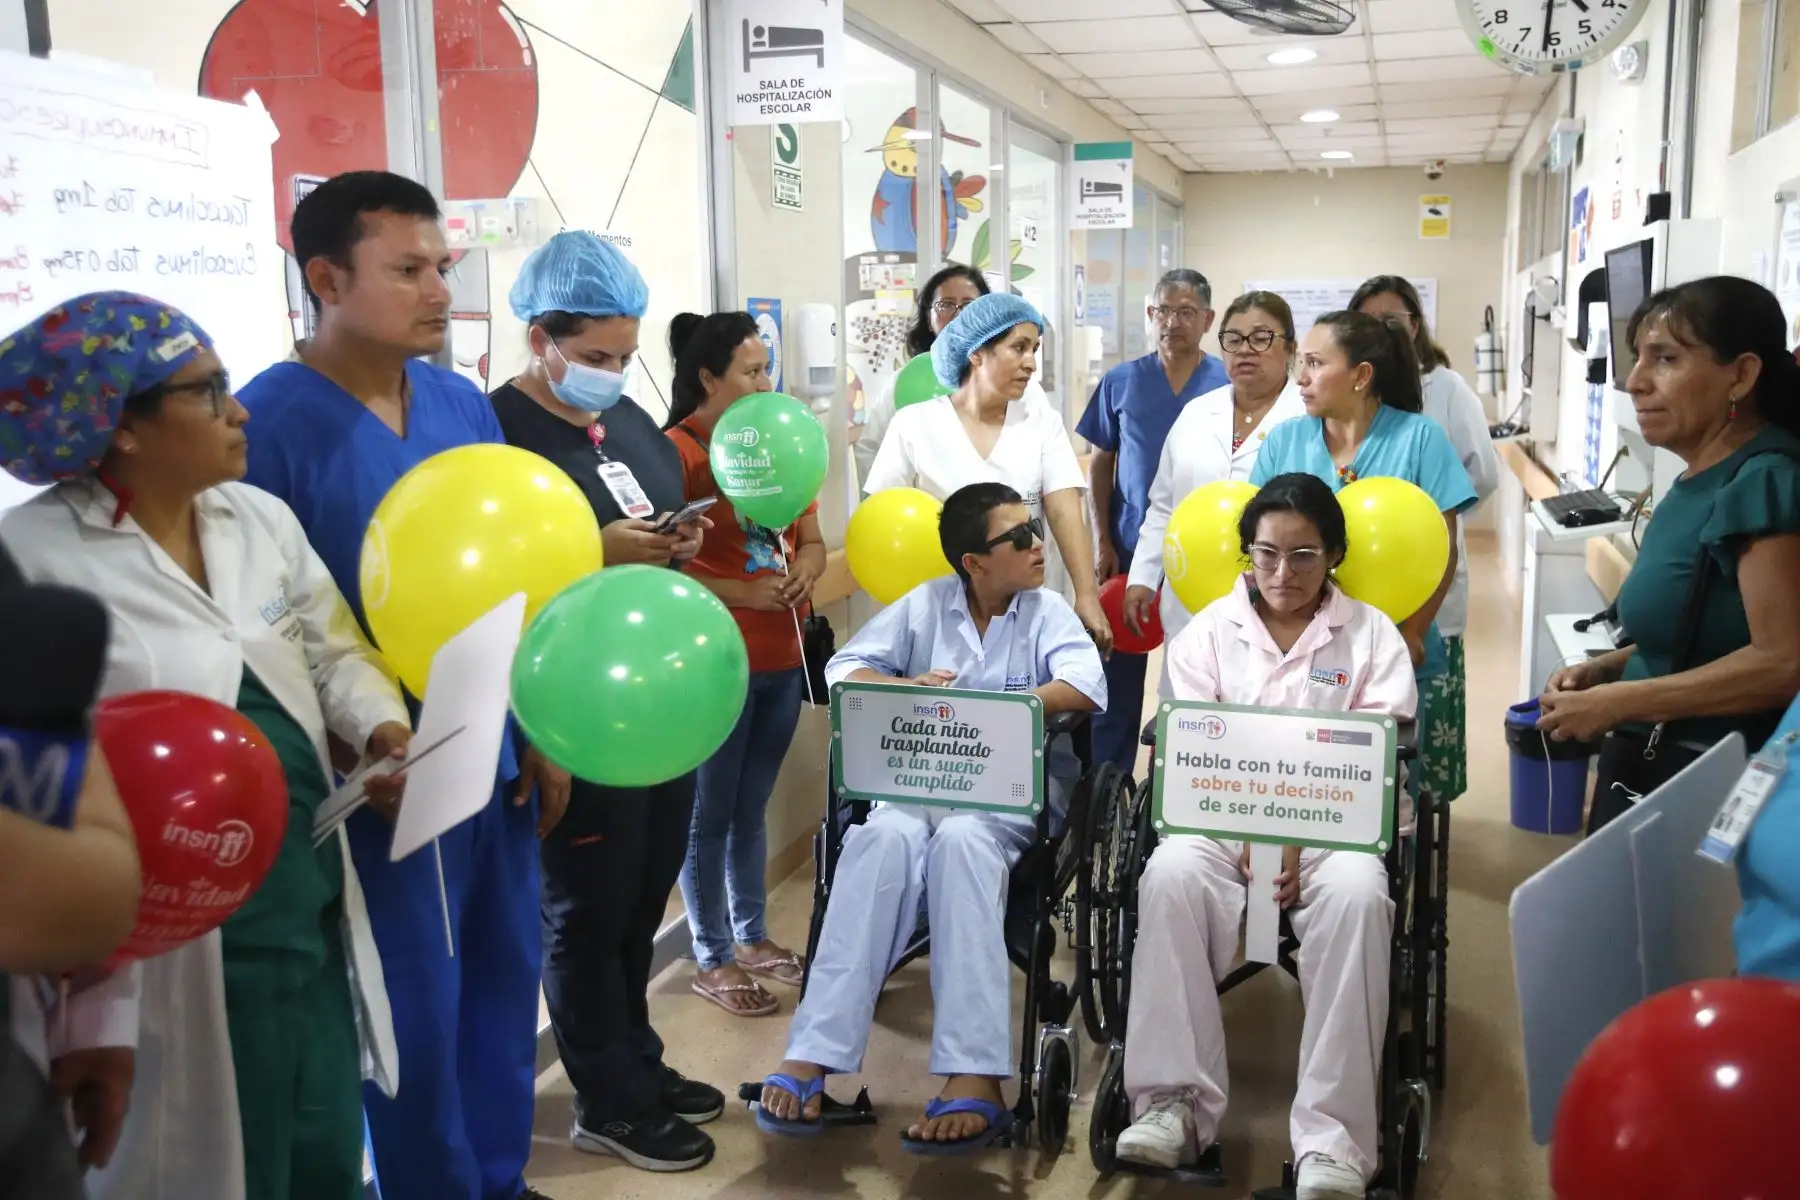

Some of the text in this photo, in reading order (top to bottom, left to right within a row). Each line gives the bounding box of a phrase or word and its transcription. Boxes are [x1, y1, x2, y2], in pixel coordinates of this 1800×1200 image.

[1495, 10, 1508, 24] 8
[1578, 19, 1592, 34] 5
[1519, 27, 1532, 42] 7
[1549, 32, 1561, 46] 6
[759, 78, 805, 90] SALA DE
[736, 88, 832, 103] HOSPITALIZACIÓN
[760, 103, 811, 114] ESCOLAR
[913, 703, 938, 715] insn
[891, 716, 982, 739] Cada niño
[1178, 717, 1206, 731] insn
[880, 734, 994, 759] trasplantado
[887, 757, 988, 775] es un sueño
[1176, 752, 1372, 782] Habla con tu familia
[894, 773, 976, 794] cumplido
[1191, 775, 1354, 802] sobre tu decisión
[1199, 796, 1343, 824] de ser donante
[163, 817, 219, 851] insn
